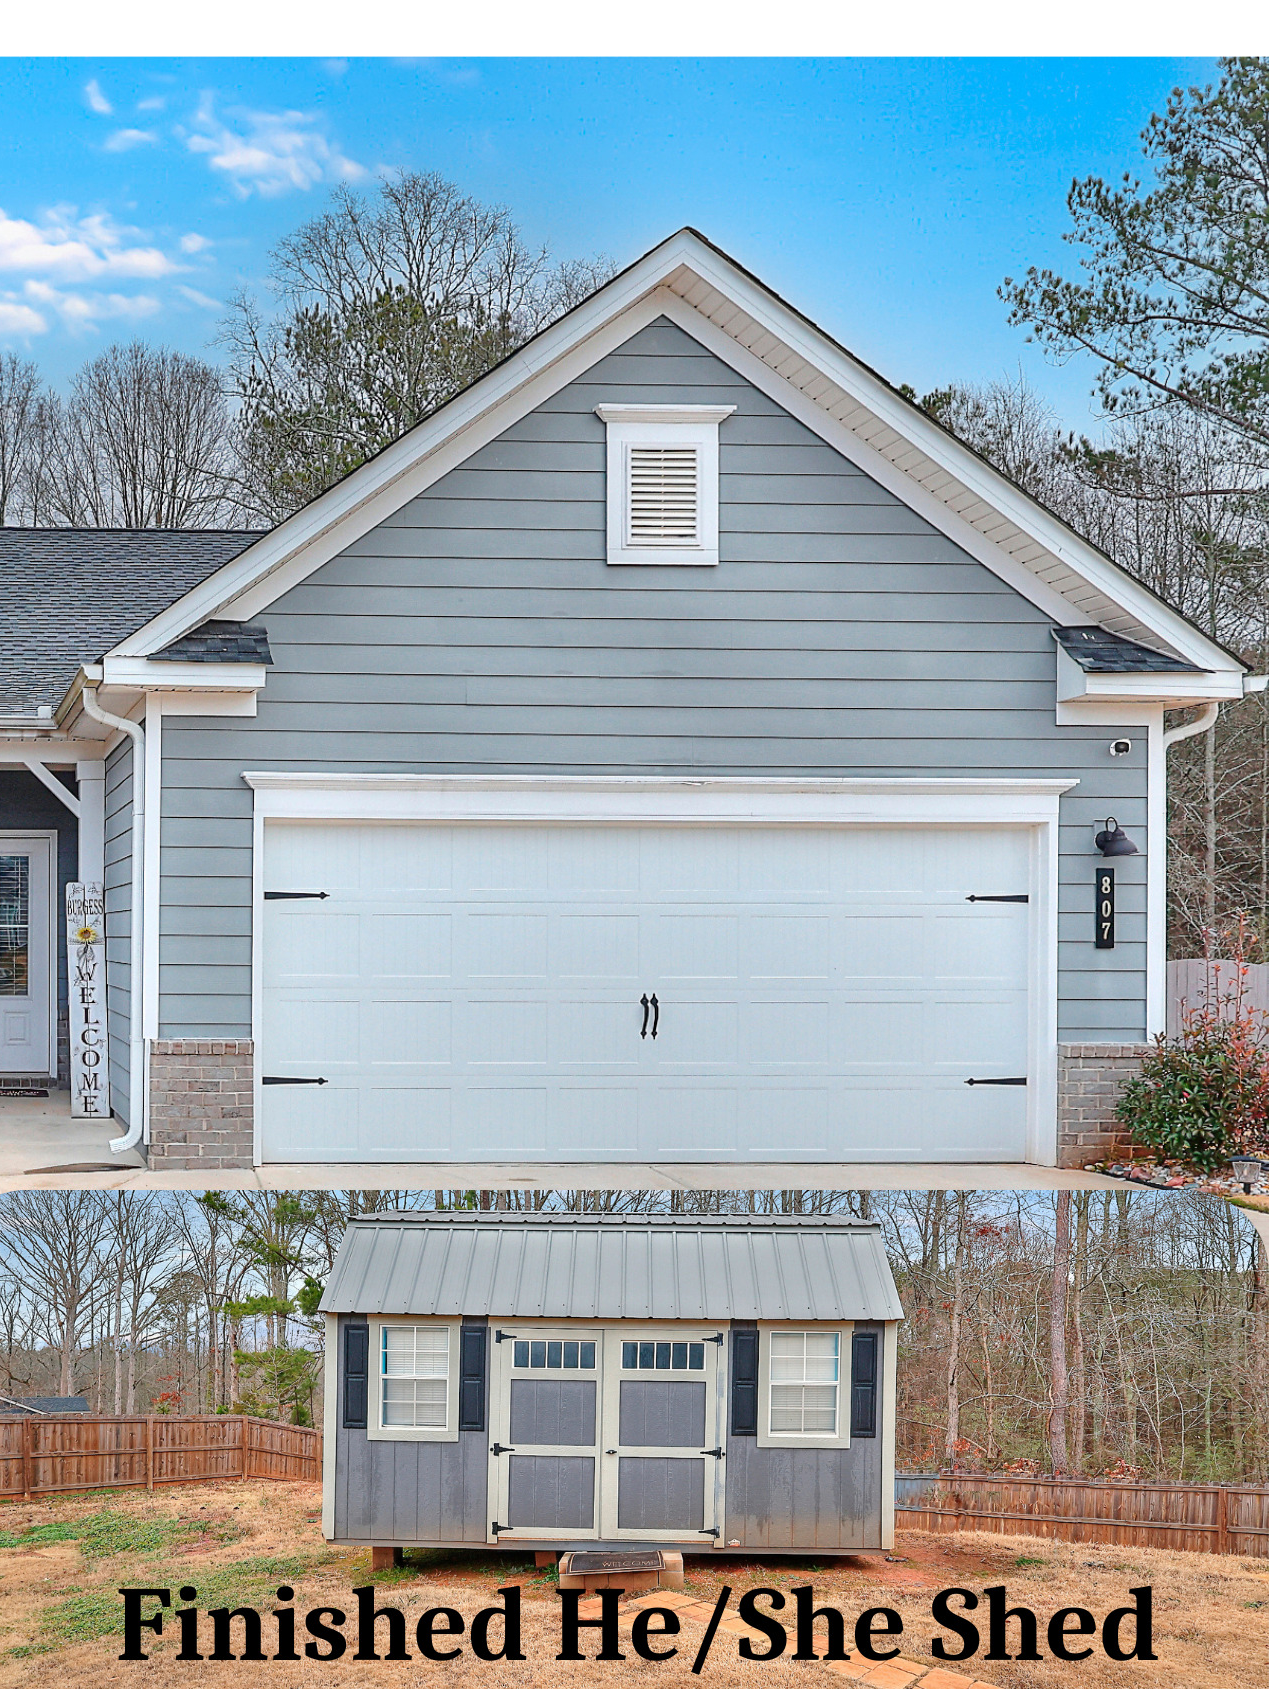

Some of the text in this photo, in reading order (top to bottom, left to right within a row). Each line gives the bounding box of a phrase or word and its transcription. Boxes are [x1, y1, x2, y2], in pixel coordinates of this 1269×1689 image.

[67, 898, 104, 915] BURGESS
[1101, 876, 1112, 940] 807
[76, 962, 102, 1113] WELCOME
